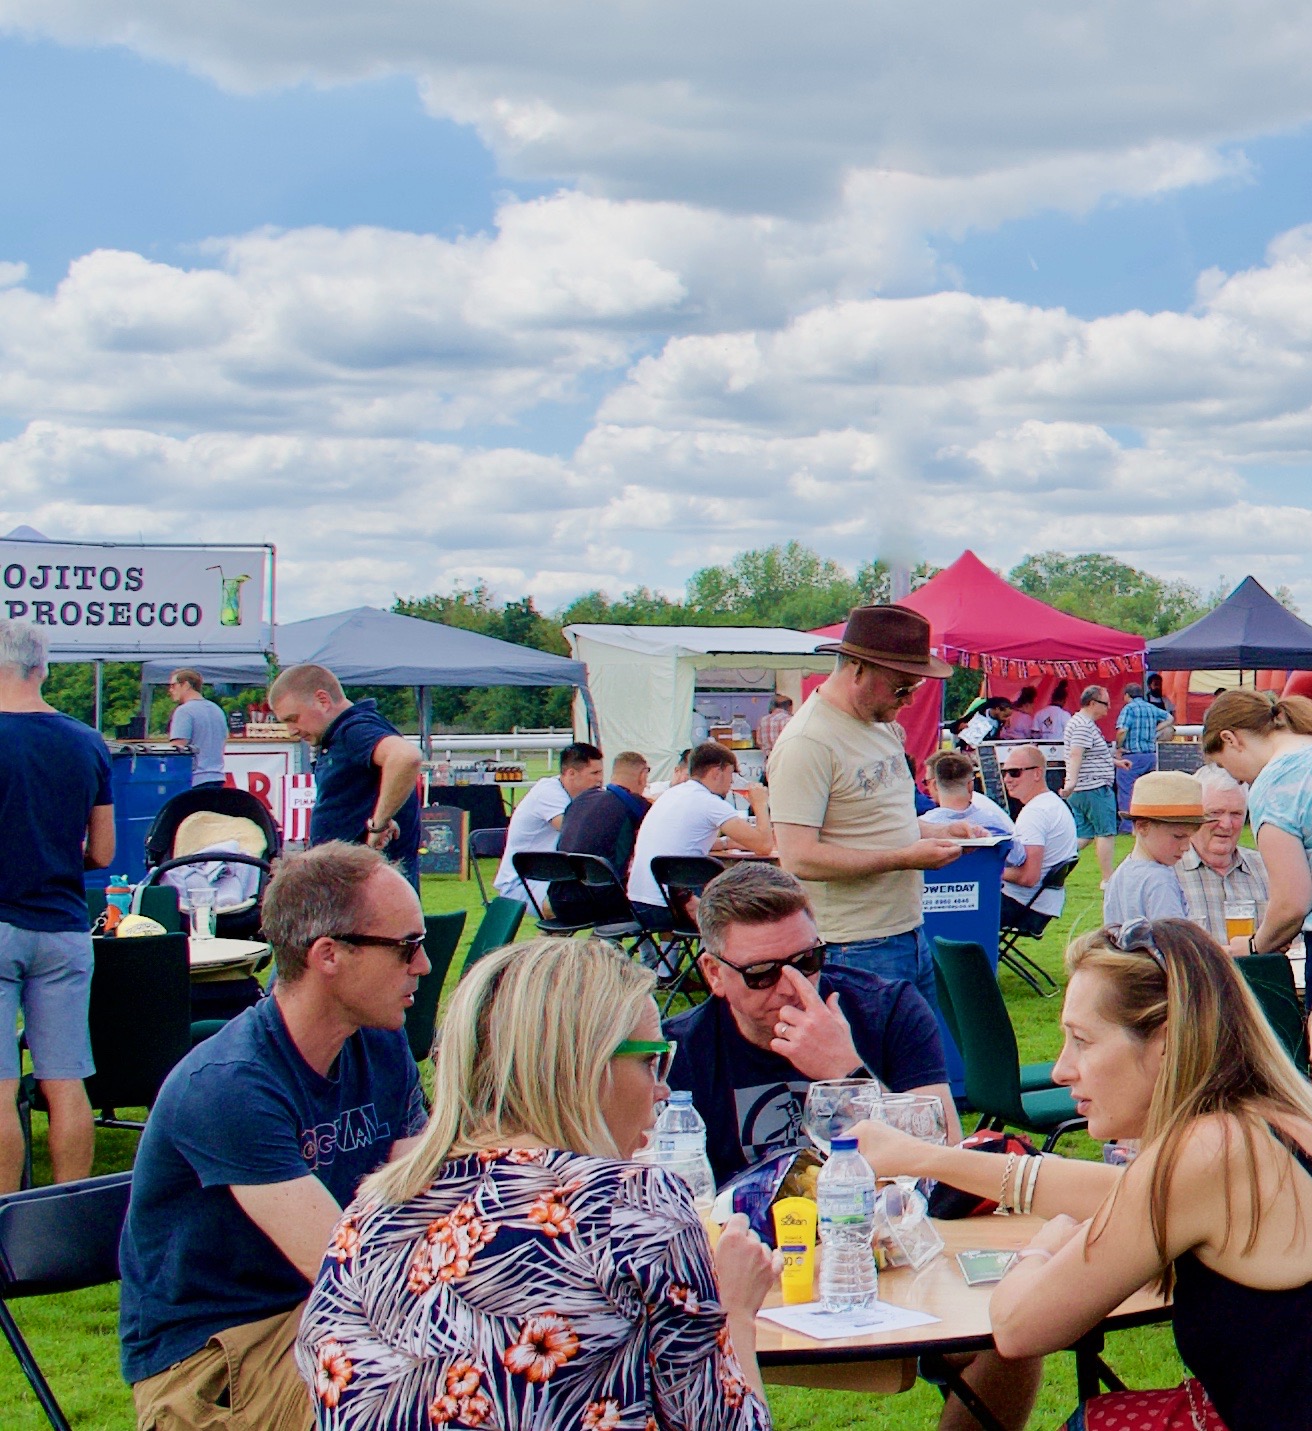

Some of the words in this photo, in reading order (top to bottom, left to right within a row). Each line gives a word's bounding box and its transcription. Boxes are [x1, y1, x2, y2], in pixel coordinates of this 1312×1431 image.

[0, 563, 144, 593] OJITOS
[5, 600, 202, 627] PROSECCO
[923, 884, 975, 893] OWERDAY
